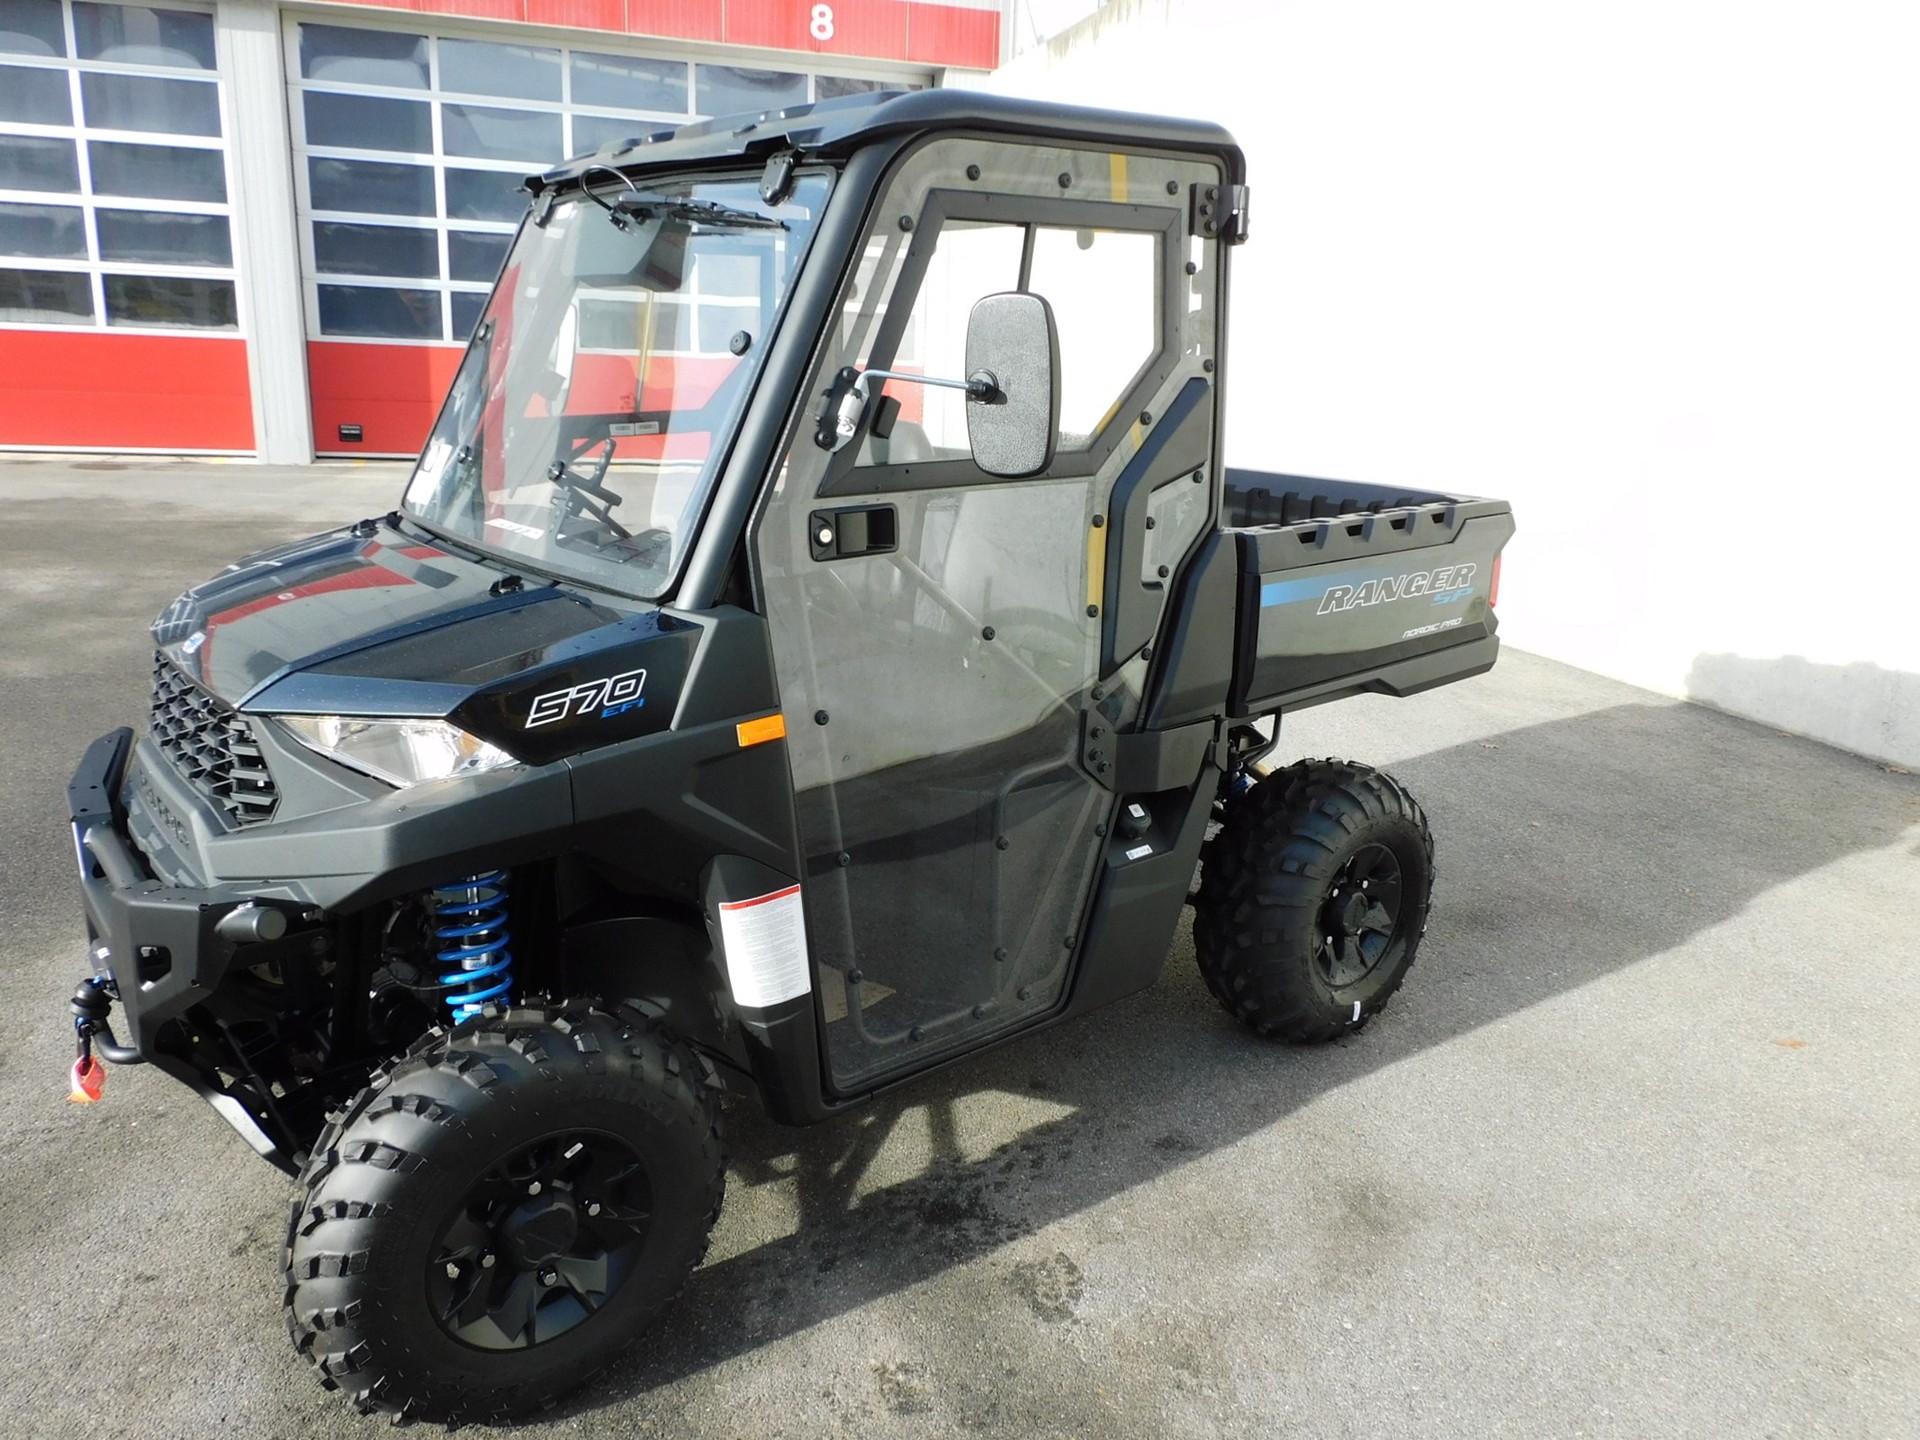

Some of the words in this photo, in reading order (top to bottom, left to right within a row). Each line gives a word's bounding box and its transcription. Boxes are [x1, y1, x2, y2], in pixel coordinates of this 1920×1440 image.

[810, 3, 834, 40] 8
[1316, 563, 1476, 615] RANGER
[1430, 587, 1475, 606] SP
[1439, 617, 1462, 629] PRO
[525, 668, 647, 729] 570
[600, 697, 647, 719] EFI
